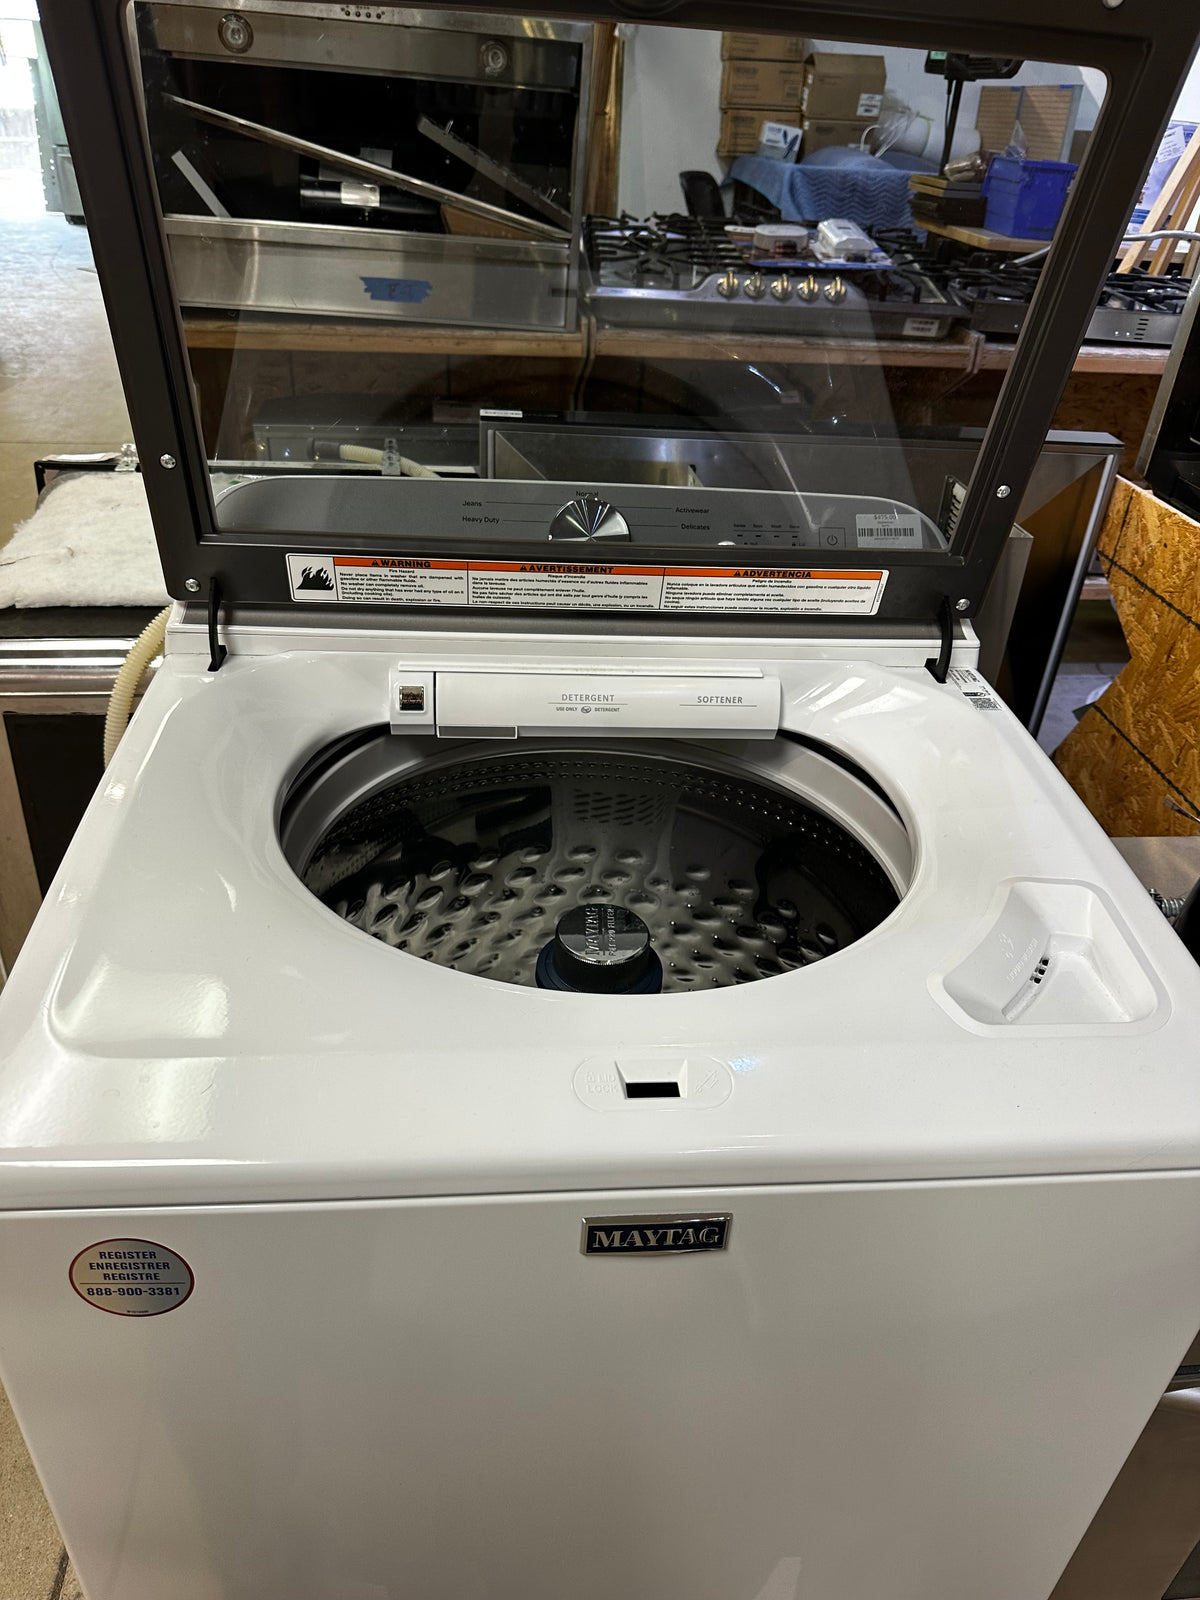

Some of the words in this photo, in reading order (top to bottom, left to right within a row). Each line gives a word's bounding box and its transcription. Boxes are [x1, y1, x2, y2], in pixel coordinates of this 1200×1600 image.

[381, 560, 431, 568] WARNING
[529, 564, 614, 573] AVERTISSEMENT
[743, 570, 811, 578] ADVERTENCIA
[562, 693, 614, 702] DETERGENT
[697, 696, 743, 704] SOFTENER
[585, 907, 600, 955] MAYTAG
[593, 1226, 720, 1248] MAYTAG
[99, 1251, 157, 1260] REGISTER
[89, 1262, 170, 1270] ENREGISTRER
[103, 1272, 160, 1281] REGISTRE
[87, 1287, 180, 1296] 888-900-3381
